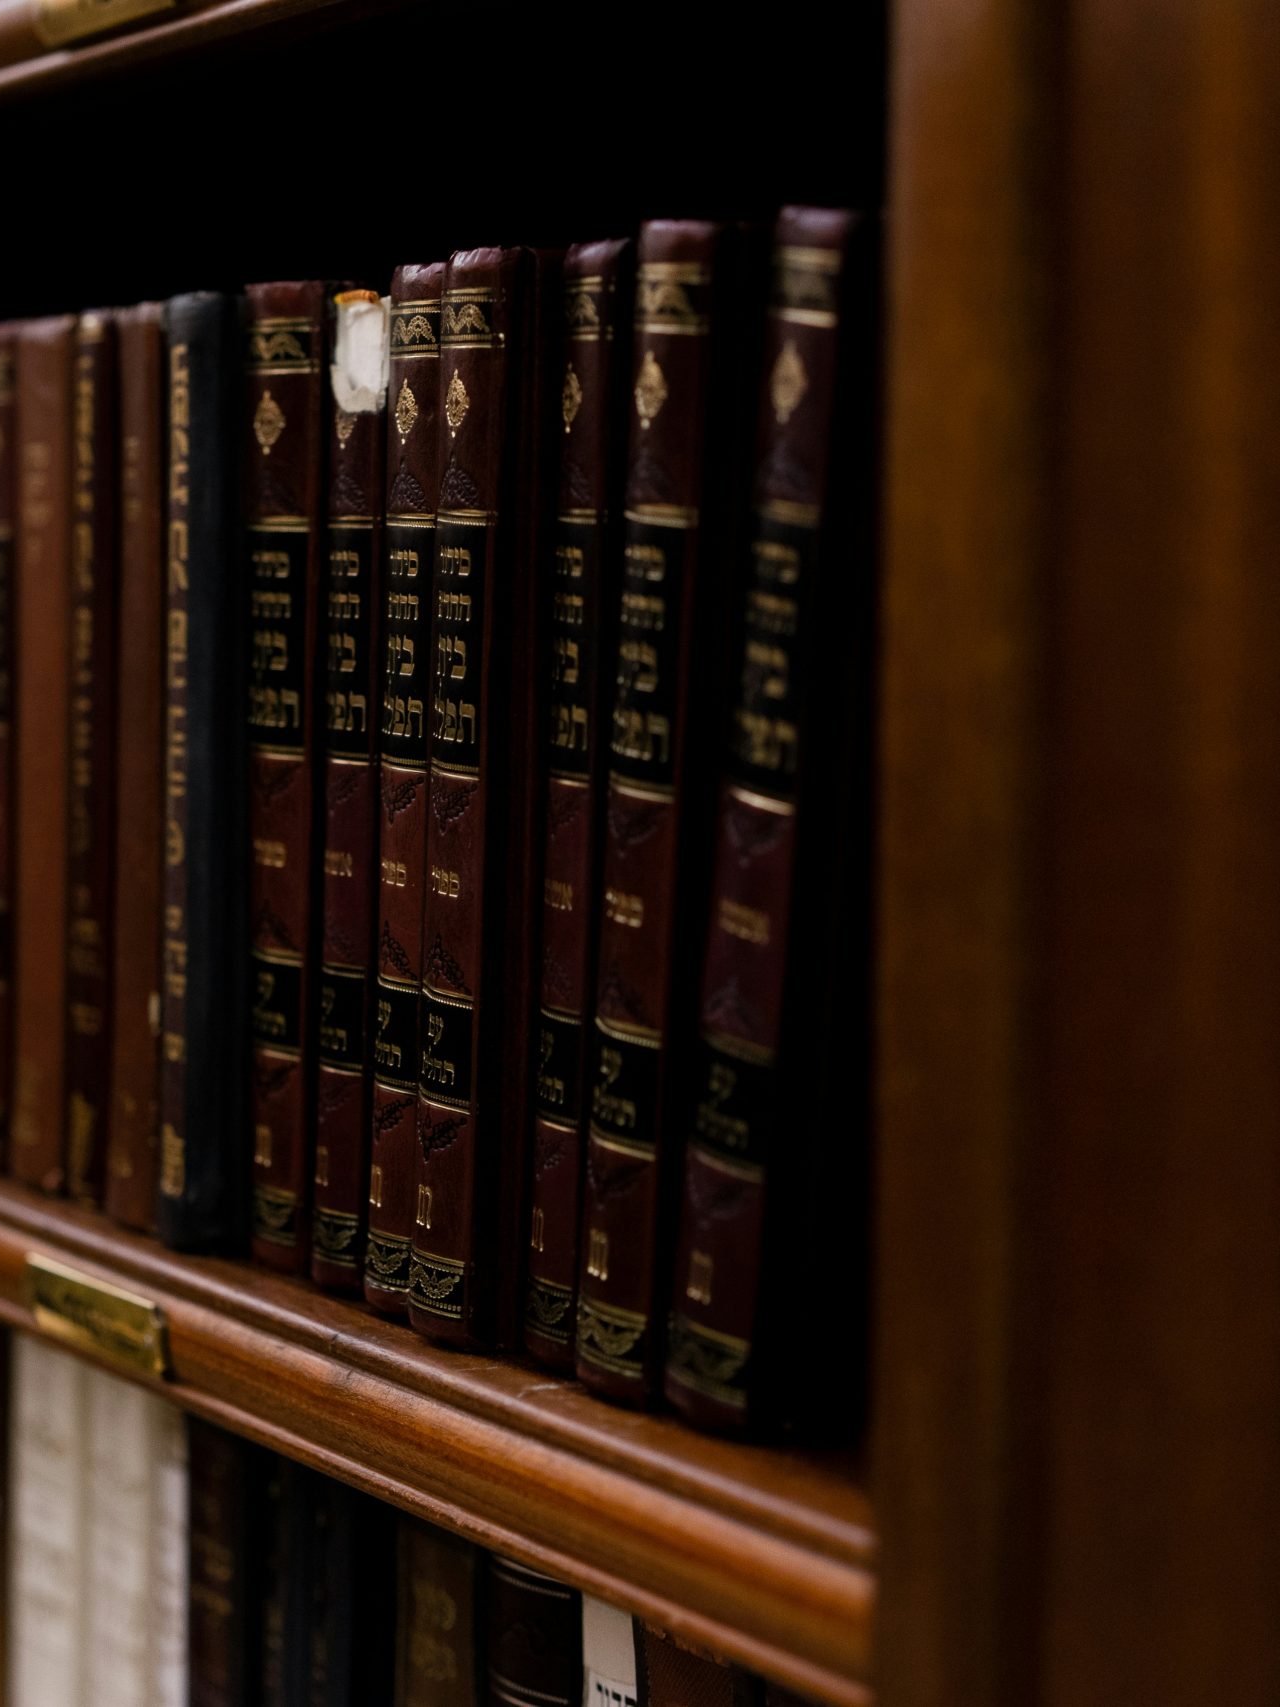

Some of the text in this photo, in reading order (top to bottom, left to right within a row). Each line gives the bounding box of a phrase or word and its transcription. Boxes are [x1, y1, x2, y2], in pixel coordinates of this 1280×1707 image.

[386, 633, 415, 676] בית
[437, 634, 466, 680] בית
[427, 1012, 445, 1045] עם
